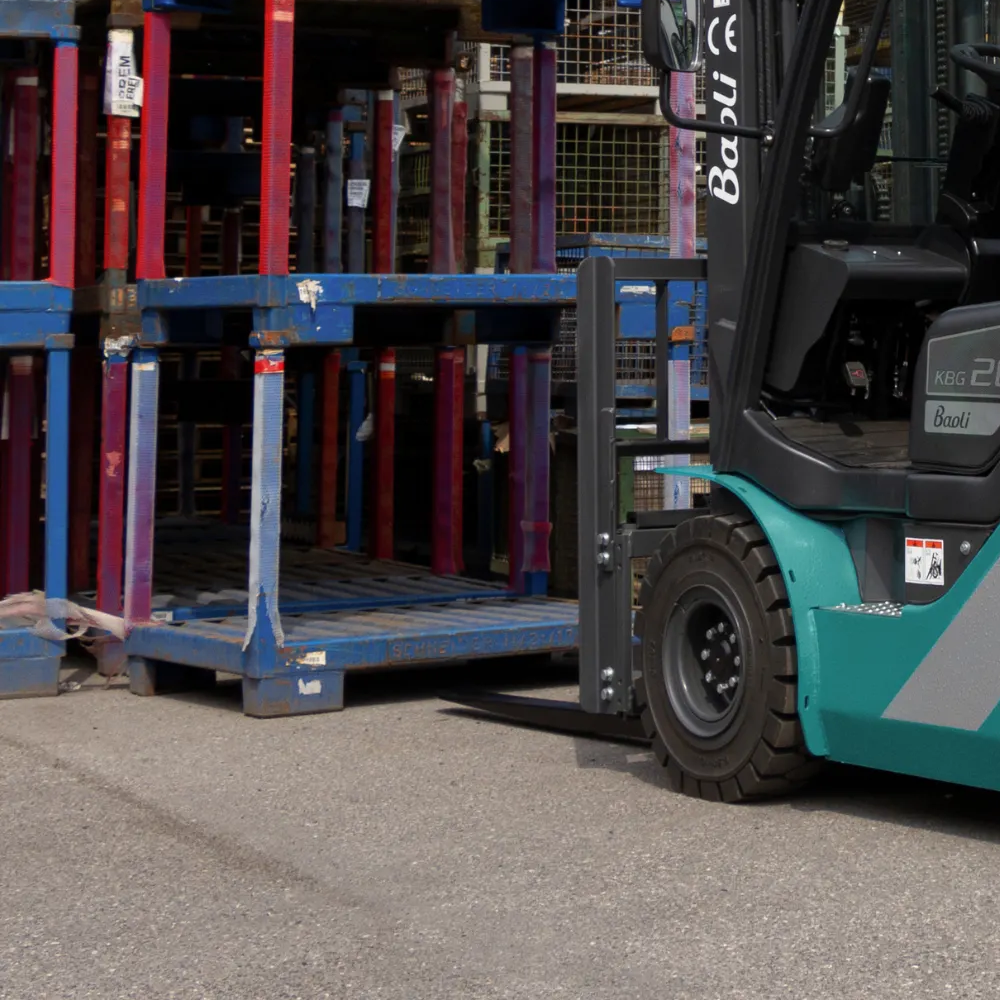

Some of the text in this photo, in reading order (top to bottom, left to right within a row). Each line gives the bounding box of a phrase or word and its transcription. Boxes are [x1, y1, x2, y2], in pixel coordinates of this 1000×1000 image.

[707, 13, 738, 56] CE
[126, 77, 138, 100] FREI
[708, 70, 740, 205] Baoli
[934, 370, 966, 386] KBG
[933, 404, 971, 429] Baoli
